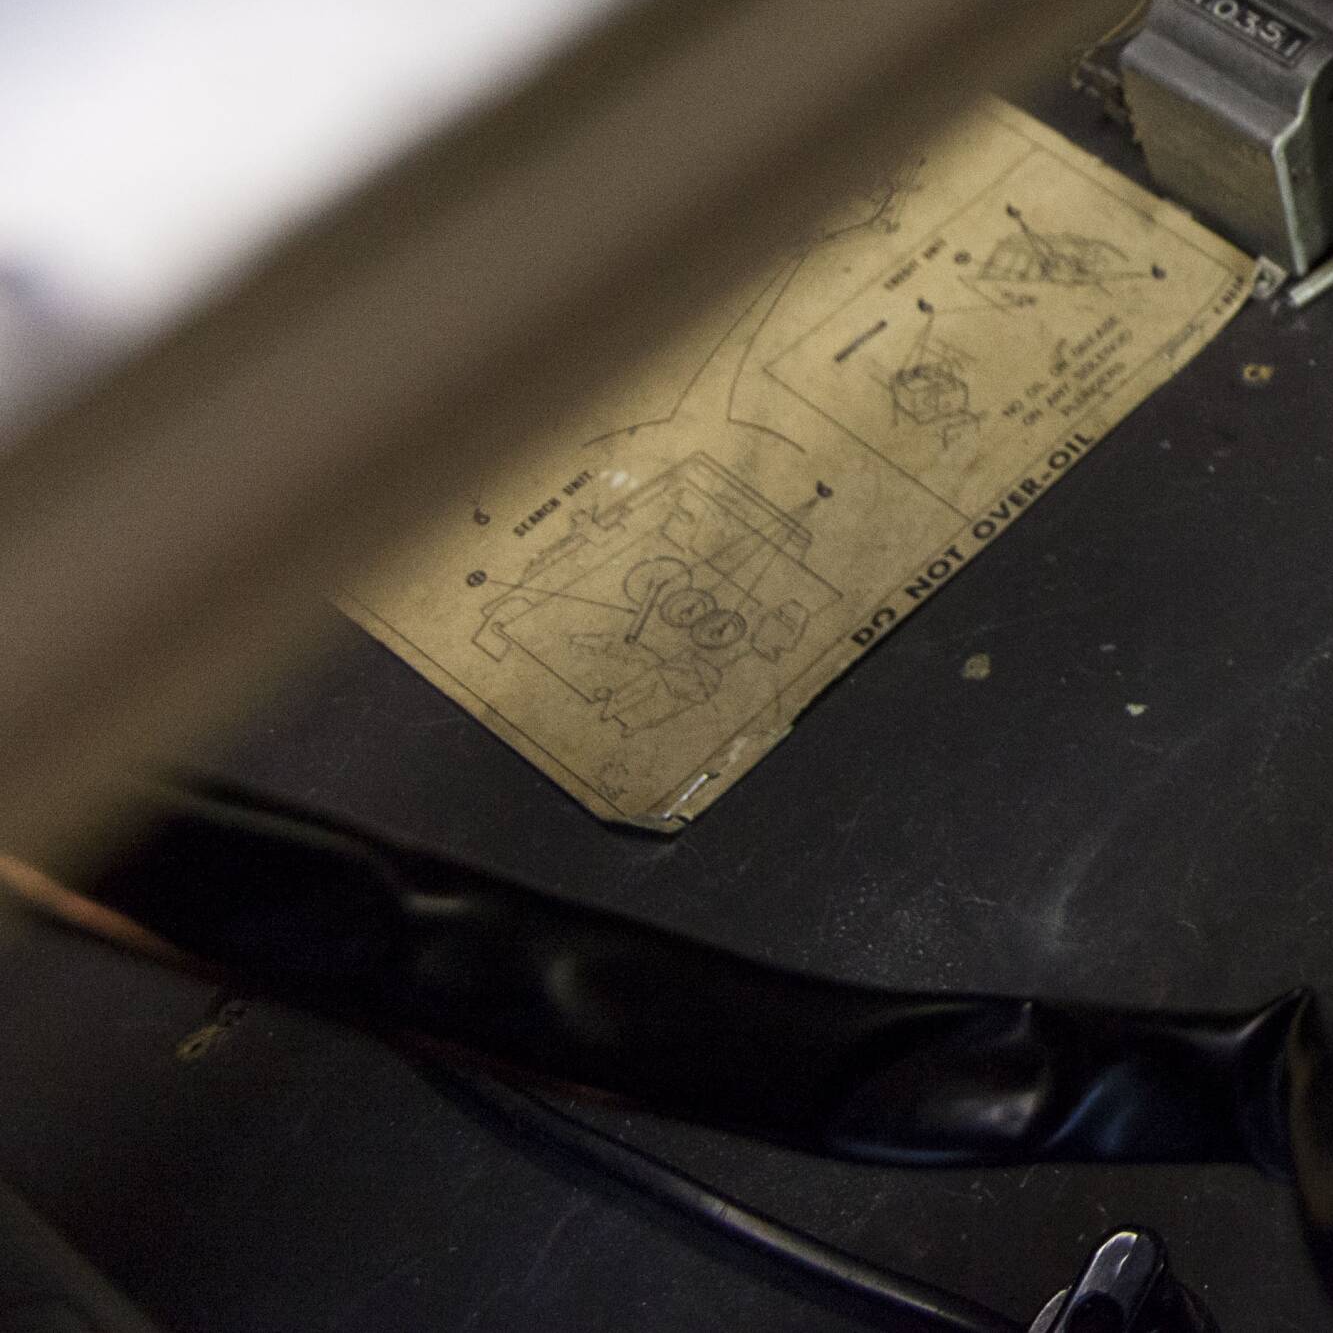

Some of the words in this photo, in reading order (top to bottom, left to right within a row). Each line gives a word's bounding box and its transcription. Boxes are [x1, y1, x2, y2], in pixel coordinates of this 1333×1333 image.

[513, 497, 561, 538] SEARCH
[851, 607, 897, 647] DO
[905, 544, 964, 600] NOT
[972, 432, 1094, 540] OVER-OIL
